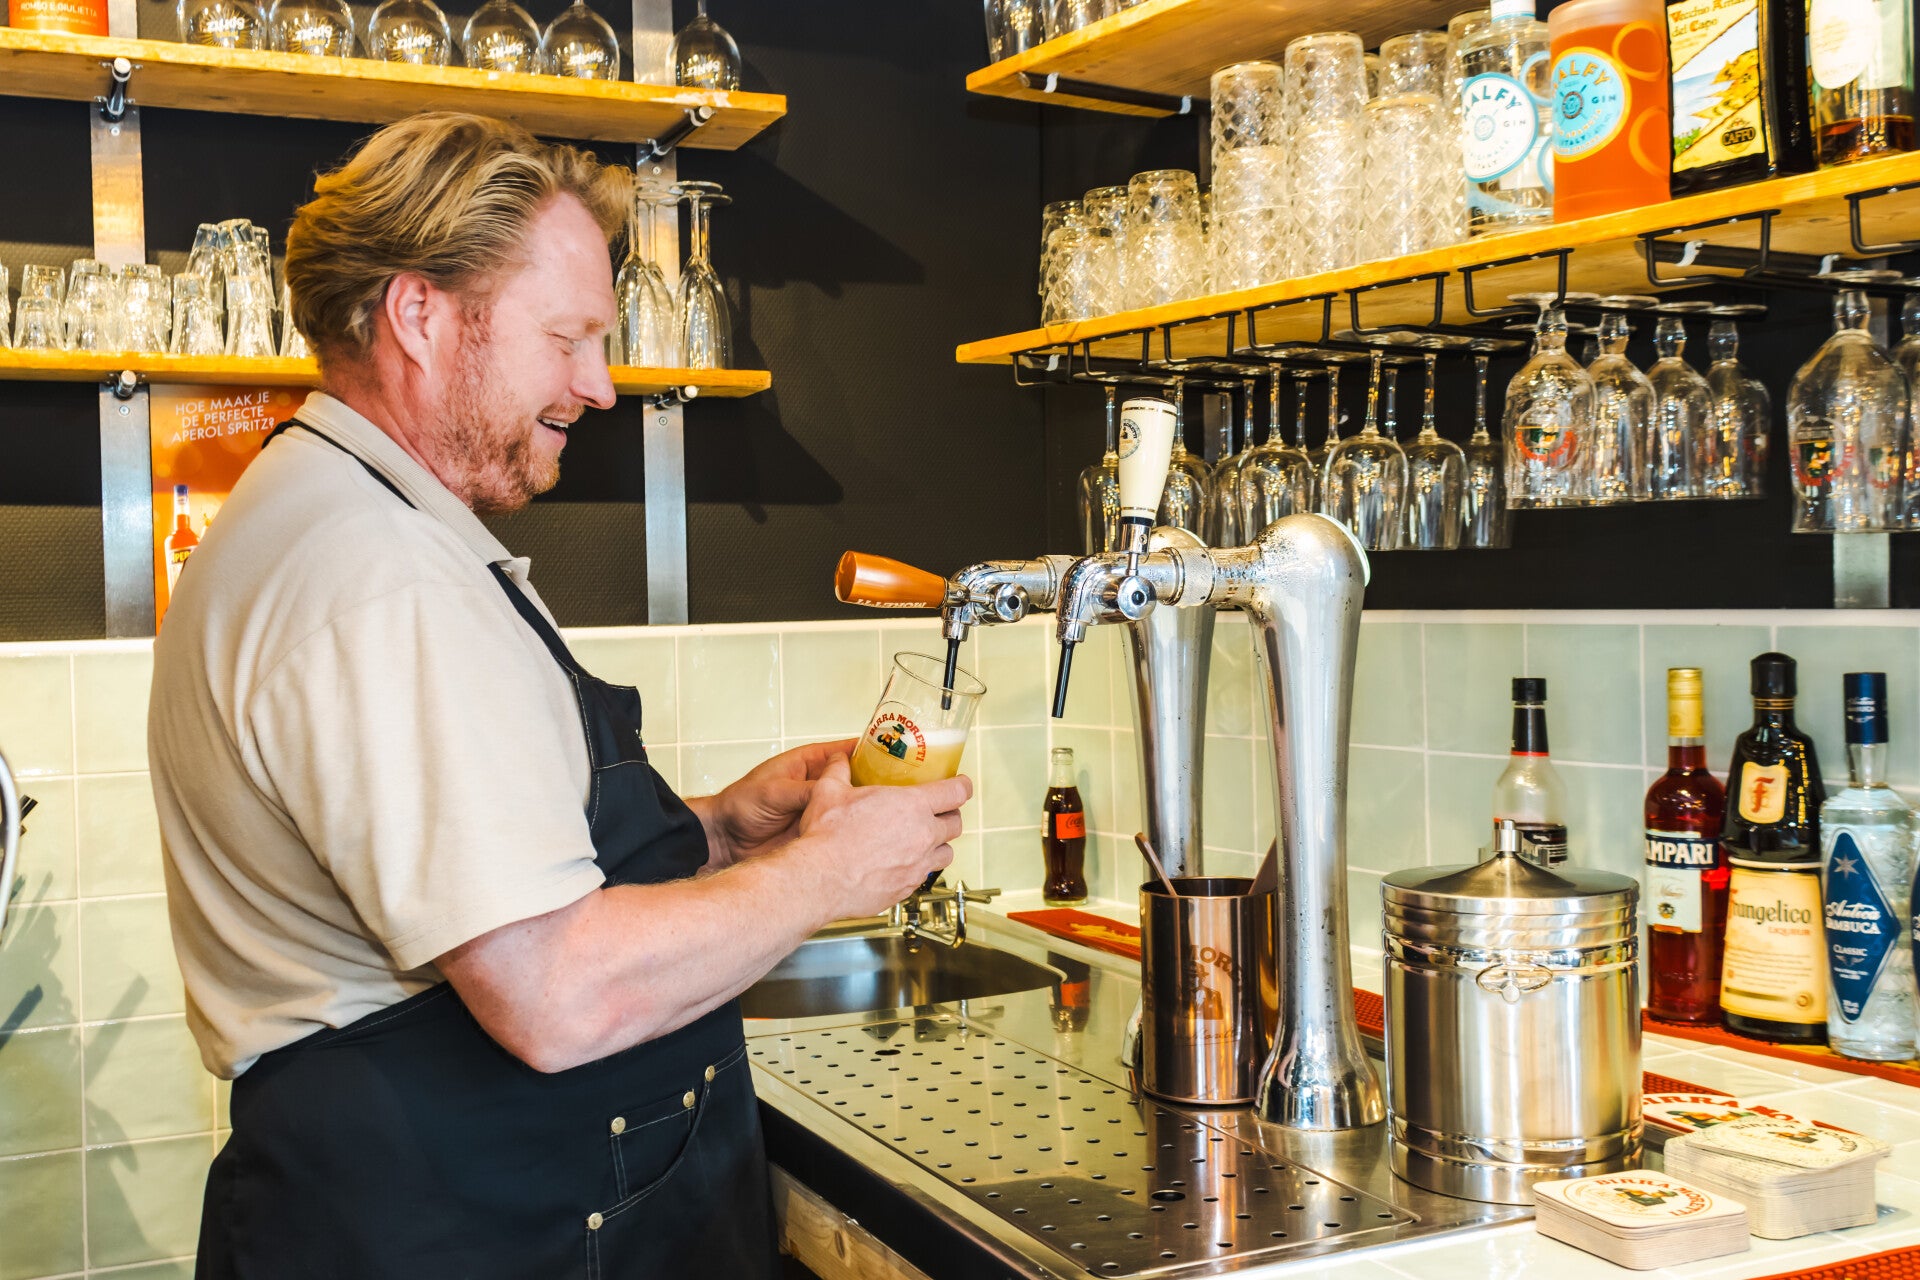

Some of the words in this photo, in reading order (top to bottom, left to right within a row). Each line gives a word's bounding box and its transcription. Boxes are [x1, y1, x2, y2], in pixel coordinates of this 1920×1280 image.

[1591, 94, 1617, 105] GIN
[1503, 119, 1527, 128] GIN
[175, 401, 205, 416] HOE
[210, 394, 252, 412] MAAK
[256, 391, 270, 405] JE
[182, 416, 200, 429] DE
[204, 405, 264, 426] PERFECTE
[171, 425, 223, 444] APEROL
[228, 417, 275, 436] SPRITZ?
[869, 712, 896, 736] BIRRA
[896, 713, 926, 763] MORETTI
[1645, 839, 1714, 865] AMPARI
[1642, 1095, 1740, 1109] IRRA
[1595, 1178, 1671, 1189] BIRRA
[1672, 1186, 1706, 1217] MORETTI
